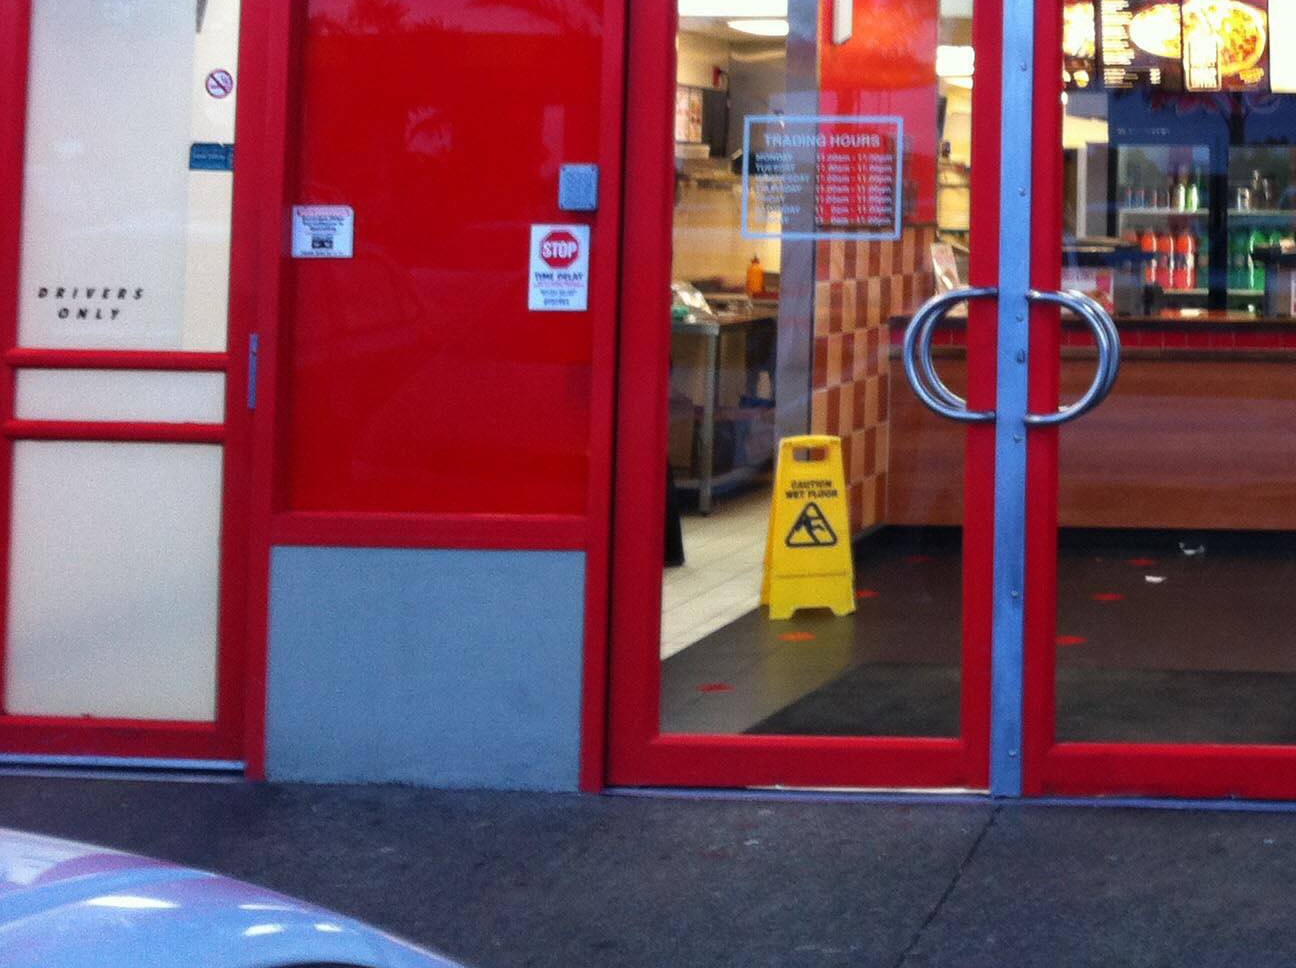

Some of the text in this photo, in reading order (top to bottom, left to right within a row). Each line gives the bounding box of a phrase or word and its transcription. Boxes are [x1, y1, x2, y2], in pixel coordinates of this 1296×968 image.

[764, 133, 881, 148] TRADING HOURS
[542, 241, 578, 259] STOP
[38, 287, 144, 300] DRIVERS
[57, 307, 120, 320] ONLY
